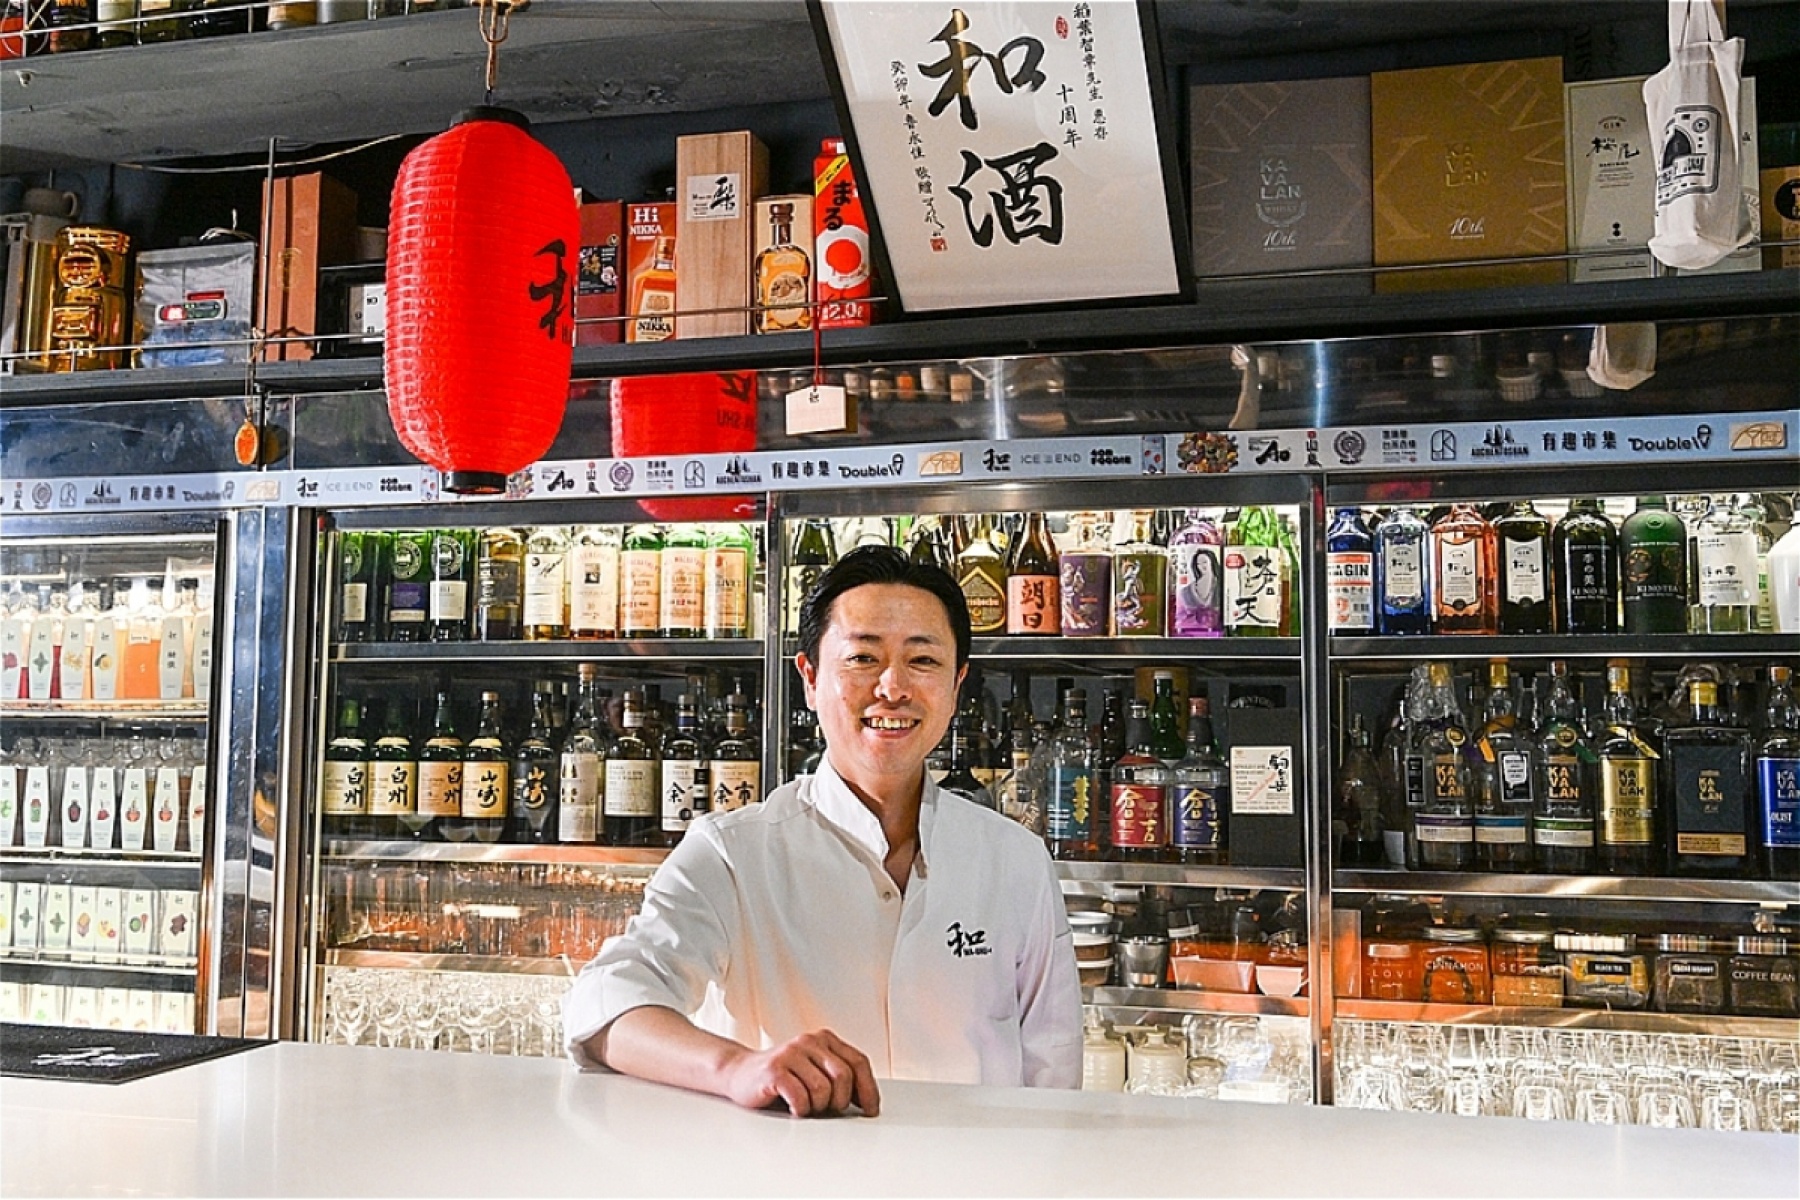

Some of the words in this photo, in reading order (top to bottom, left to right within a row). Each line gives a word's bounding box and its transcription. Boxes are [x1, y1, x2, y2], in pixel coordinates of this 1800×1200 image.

[1056, 84, 1083, 149] 十周年
[918, 9, 1064, 248] 和酒
[1260, 159, 1288, 172] KA
[1260, 173, 1288, 186] VA
[1260, 186, 1301, 200] LAN
[824, 181, 856, 231] まる
[633, 207, 659, 223] Hi
[629, 224, 663, 236] NIKKA
[1541, 430, 1618, 452] 有趣市集
[1055, 453, 1081, 464] END
[771, 459, 830, 479] 有趣市集
[1345, 564, 1369, 576] GIN
[1548, 766, 1570, 777] KA
[343, 766, 365, 809] 白州
[387, 765, 409, 808] 白州
[1548, 777, 1570, 788] VA
[713, 780, 755, 806] 余市
[1548, 787, 1579, 799] LAN
[946, 921, 986, 958] 和
[1425, 961, 1484, 973] CINNAMON
[1732, 971, 1769, 981] COFFEE
[1770, 972, 1796, 982] BEAN
